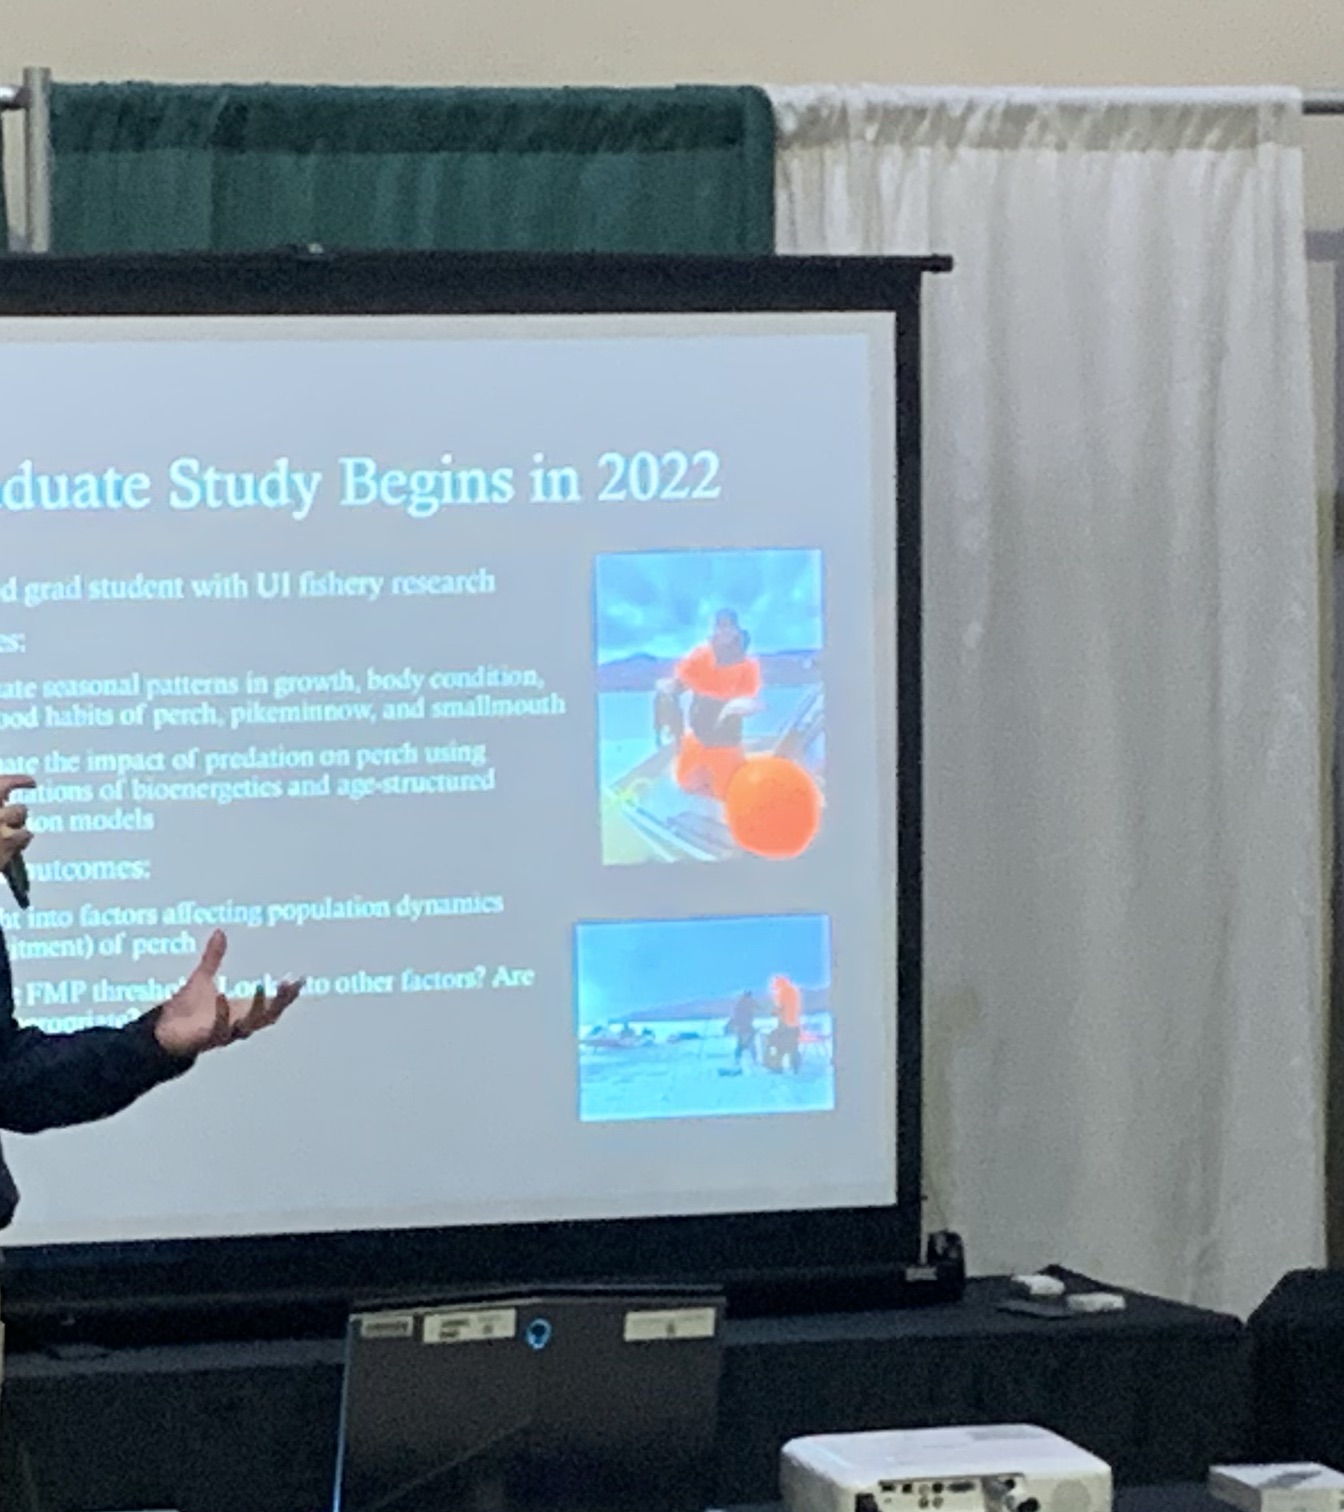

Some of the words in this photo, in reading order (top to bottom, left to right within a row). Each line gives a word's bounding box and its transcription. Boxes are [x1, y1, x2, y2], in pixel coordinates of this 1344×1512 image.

[170, 457, 322, 520] Study
[339, 453, 515, 518] Begins
[530, 452, 581, 503] in
[598, 450, 721, 501] 2022
[25, 574, 82, 608] grad
[88, 573, 184, 600] student
[191, 572, 248, 598] with
[257, 572, 290, 598] UI
[300, 570, 383, 601] fishery
[392, 567, 496, 594] research
[43, 672, 139, 698] seasonal
[146, 674, 238, 702] patterns
[246, 671, 268, 694] in
[275, 669, 361, 698] growth,
[368, 667, 424, 694] body
[429, 664, 545, 690] condition,
[45, 703, 113, 727] habits
[121, 703, 146, 726] of
[153, 702, 224, 731] perch,
[231, 699, 376, 730] pikeminnow,
[384, 697, 424, 721] and
[431, 693, 566, 719] smallmouth
[45, 751, 80, 772] the
[88, 751, 166, 775] impact
[172, 747, 199, 770] of
[206, 747, 314, 776] predation
[320, 749, 350, 768] on
[356, 741, 418, 771] perch
[425, 739, 486, 768] using
[99, 779, 126, 800] of
[133, 775, 282, 804] bioenergetics
[288, 773, 330, 796] and
[337, 767, 495, 801] age-structured
[70, 807, 154, 831] models
[27, 905, 74, 929] into
[80, 903, 157, 927] factors
[162, 899, 264, 928] affecting
[266, 895, 391, 926] population
[395, 891, 504, 922] dynamics
[8, 933, 94, 961] itment)
[99, 932, 126, 955] of
[132, 931, 196, 961] perch
[26, 979, 87, 1006] FMP
[335, 970, 394, 994] other
[401, 964, 487, 993] factors?
[492, 964, 535, 989] Are
